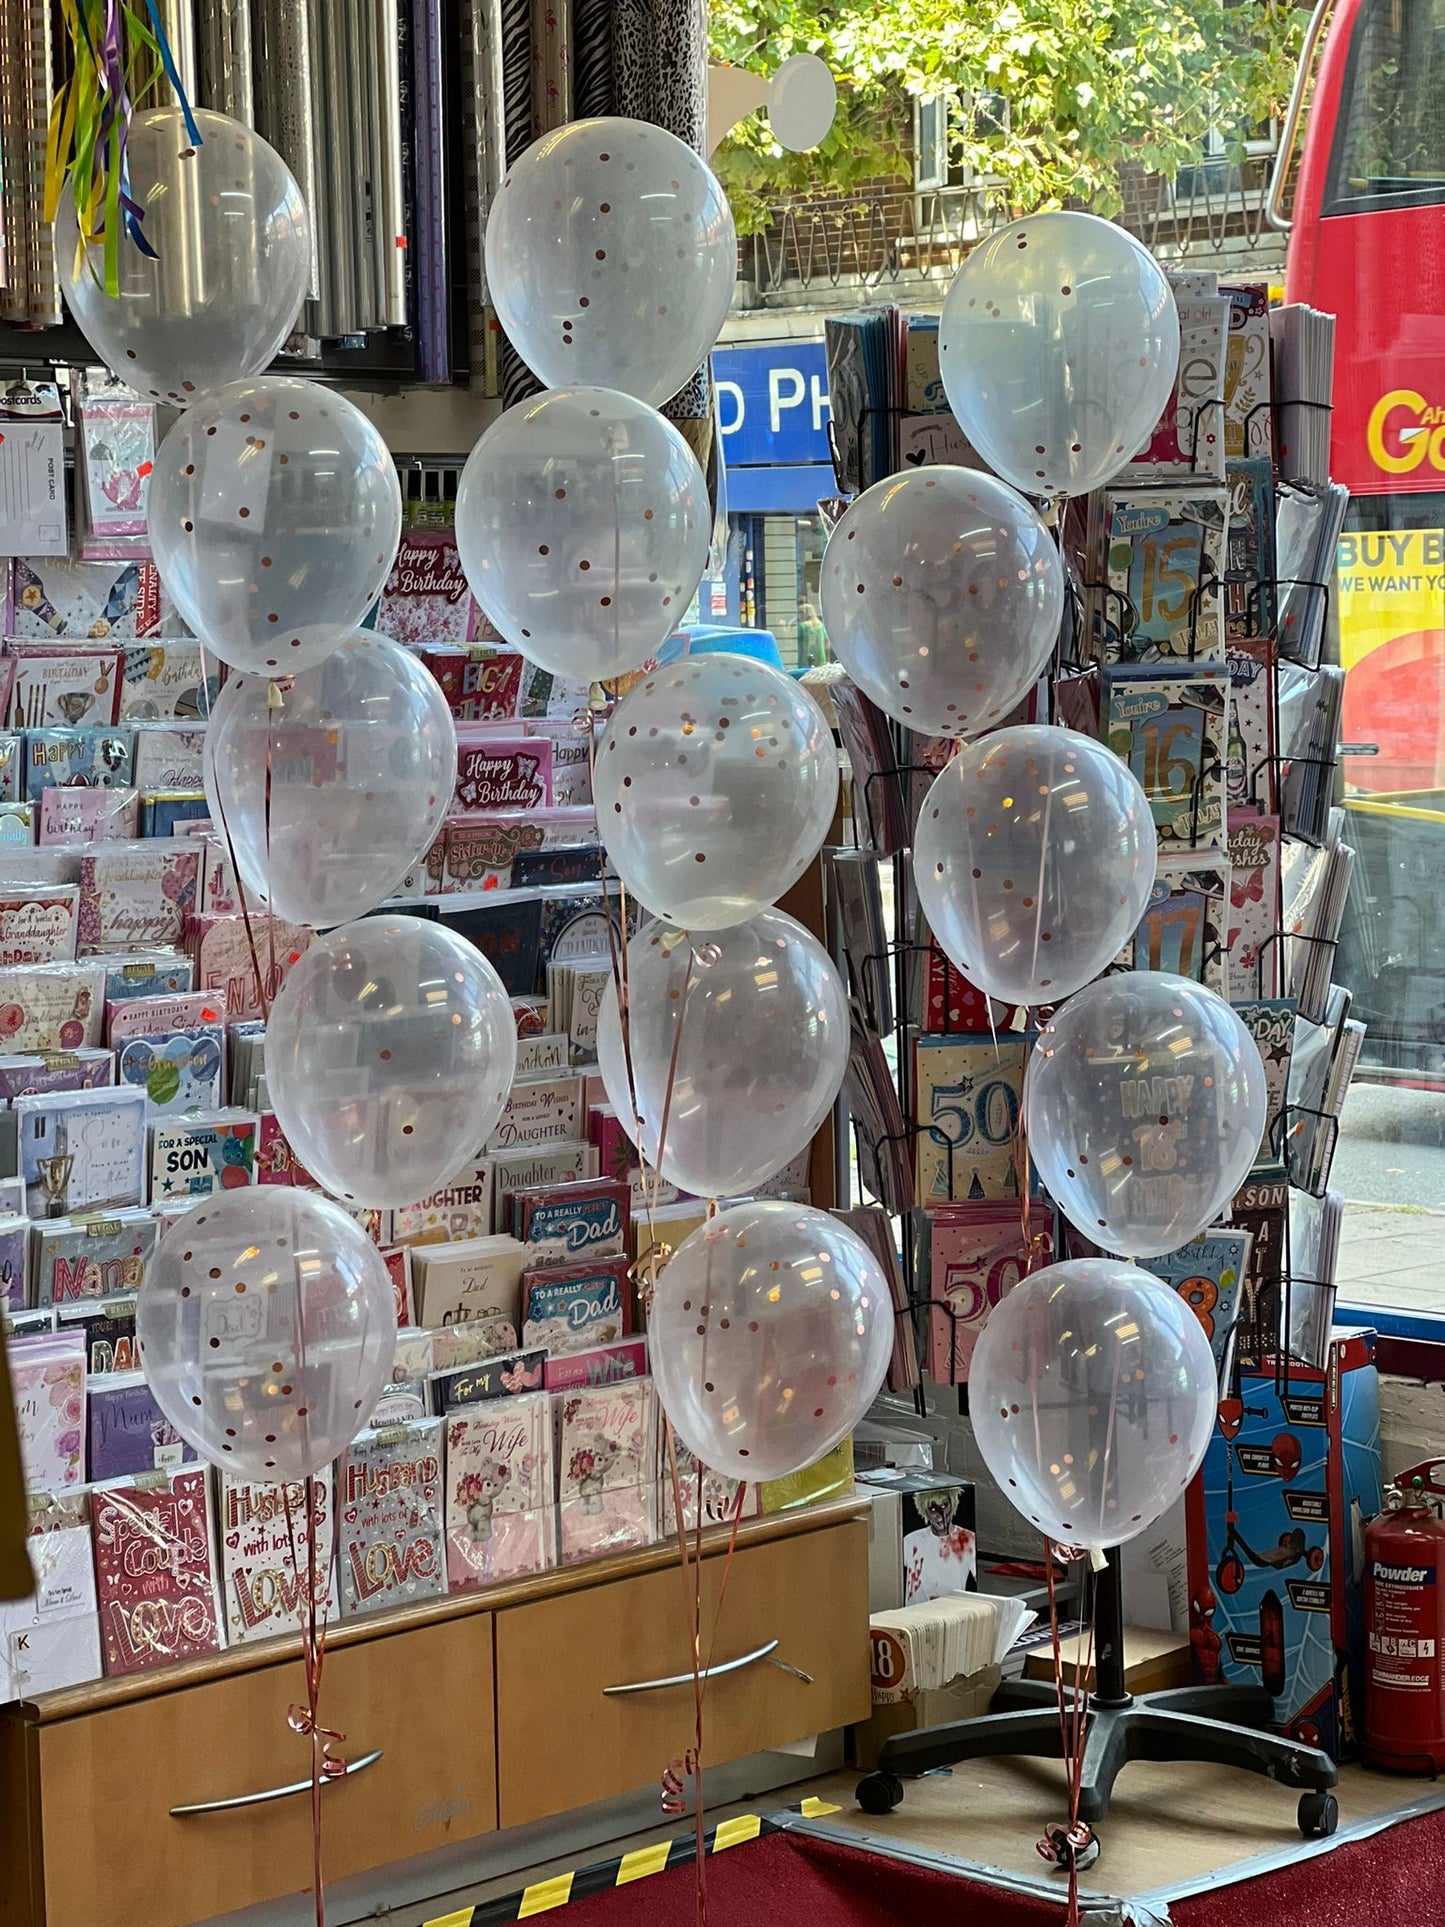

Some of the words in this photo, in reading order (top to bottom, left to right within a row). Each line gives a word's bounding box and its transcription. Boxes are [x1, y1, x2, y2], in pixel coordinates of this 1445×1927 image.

[0, 393, 42, 406] ostcards
[716, 381, 745, 435] D
[769, 368, 831, 432] PH
[1420, 406, 1445, 425] Ah
[47, 456, 55, 477] POST
[1338, 535, 1414, 567] BUY
[401, 570, 465, 600] Birthday
[1141, 538, 1196, 623] 15
[1339, 576, 1364, 592] WE
[1368, 576, 1423, 592] WANT
[42, 668, 88, 680] BIRTHDAY
[466, 754, 514, 782] Happy
[1141, 725, 1195, 804] 16
[479, 780, 540, 808] Birthday
[46, 817, 96, 841] birthday
[1229, 850, 1269, 868] ishes
[5, 924, 67, 941] Granddaughter
[1146, 907, 1201, 980] 17
[129, 1009, 150, 1021] HAPPY
[151, 1004, 185, 1017] BIRTHDAY
[929, 1080, 1021, 1149] 50
[158, 1140, 174, 1151] FOR
[176, 1139, 182, 1147] A
[184, 1134, 218, 1147] SPECIAL
[500, 1123, 567, 1148] DAUGHTER
[166, 1147, 209, 1174] SON
[500, 1163, 557, 1190] Daughter
[1245, 1188, 1284, 1208] SON
[535, 1211, 546, 1221] TO
[547, 1210, 554, 1219] A
[555, 1207, 582, 1218] REALLY
[568, 1203, 618, 1247] Dad
[53, 1256, 144, 1302] Nana
[462, 1276, 488, 1294] Dad
[535, 1289, 545, 1300] TO
[547, 1288, 553, 1297] A
[555, 1284, 582, 1296] REALLY
[944, 1255, 1029, 1323] 50
[568, 1280, 619, 1327] Dad
[91, 1336, 141, 1376] DA
[453, 1378, 474, 1403] For
[476, 1373, 491, 1392] my
[101, 1403, 154, 1450] Mum
[597, 1401, 638, 1436] Wife
[483, 1423, 529, 1460] Wife
[362, 1517, 380, 1529] with
[382, 1513, 397, 1527] lots
[399, 1509, 409, 1524] of
[124, 1528, 208, 1577] Couple
[243, 1534, 270, 1557] with
[272, 1532, 296, 1552] lots
[348, 1556, 439, 1601] Love
[1373, 1562, 1428, 1583] Powder
[142, 1579, 169, 1595] with
[233, 1565, 331, 1629] Love
[18, 1634, 30, 1651] K
[110, 1595, 212, 1666] Love
[1409, 1639, 1418, 1648] C
[869, 1636, 895, 1678] 18
[871, 1688, 896, 1703] Happy
